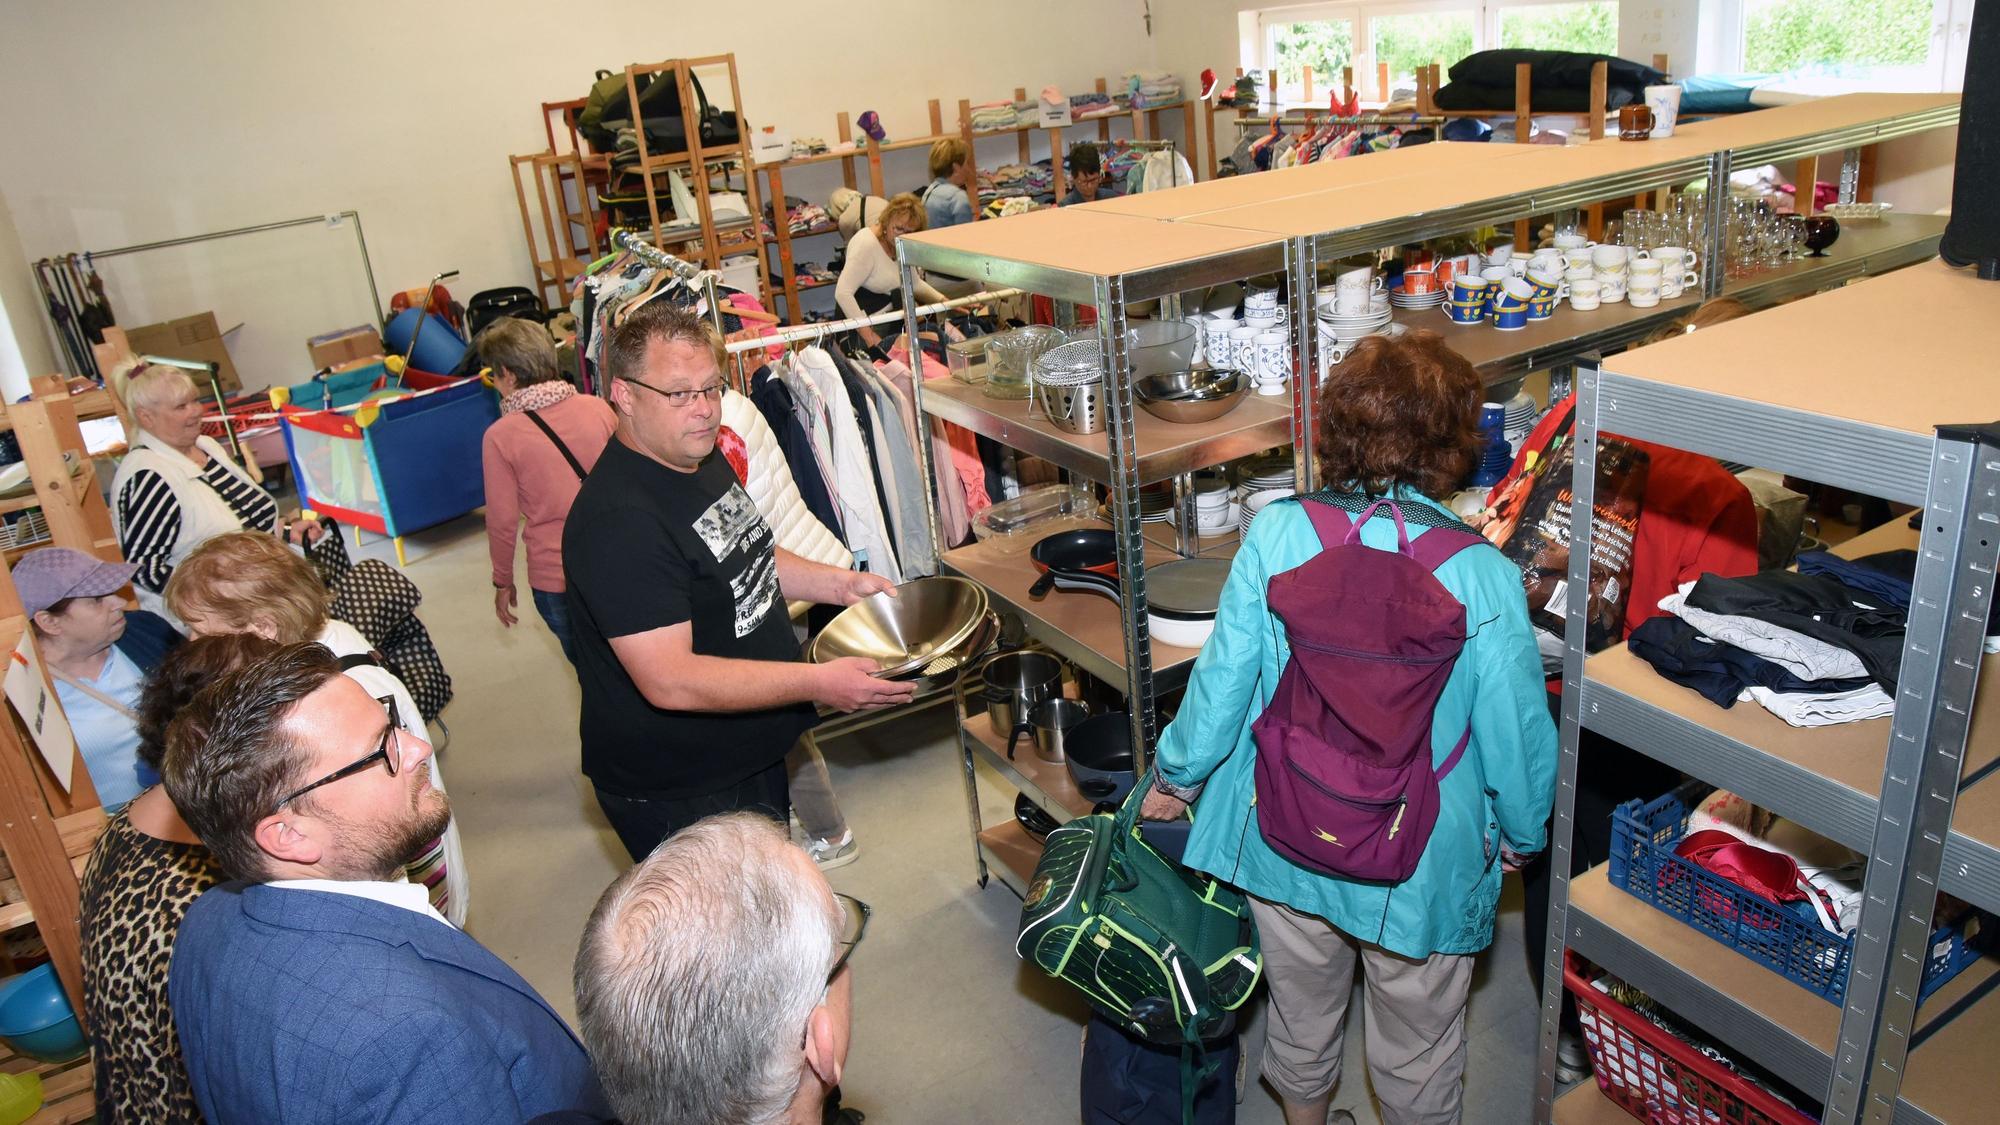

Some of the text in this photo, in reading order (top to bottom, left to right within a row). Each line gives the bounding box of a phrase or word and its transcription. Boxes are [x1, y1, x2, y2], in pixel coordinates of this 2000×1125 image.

[748, 528, 763, 545] AND
[1611, 523, 1633, 543] Lebensd
[1555, 537, 1570, 549] Ress
